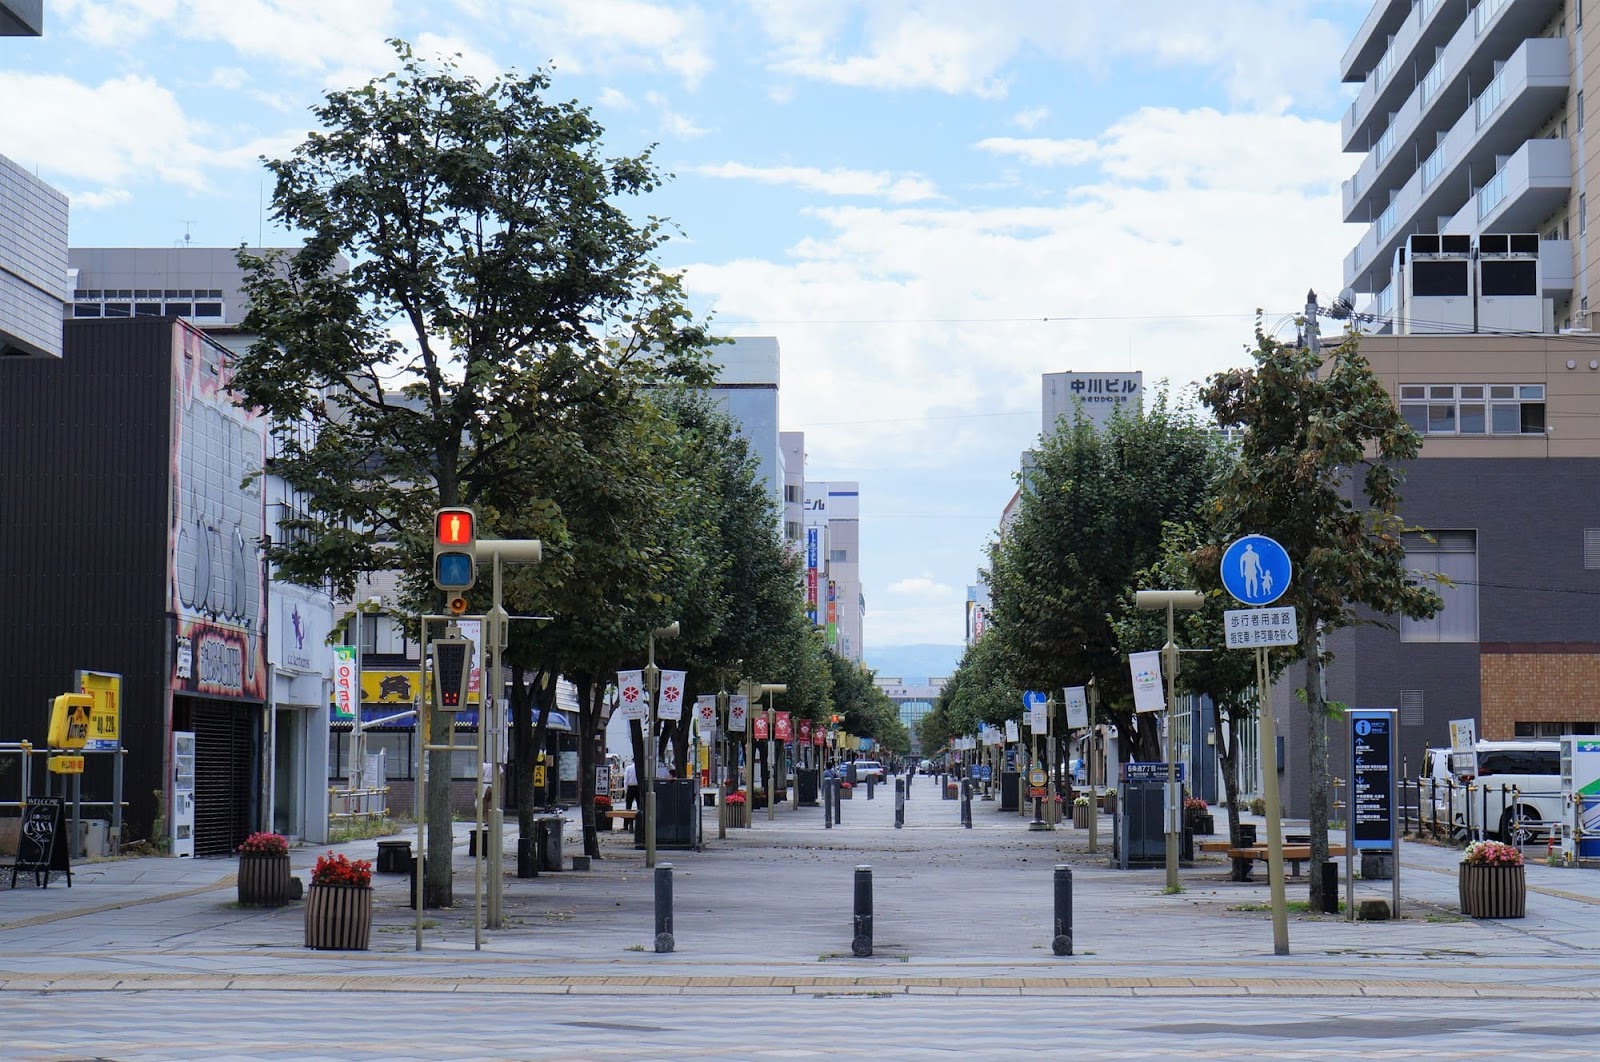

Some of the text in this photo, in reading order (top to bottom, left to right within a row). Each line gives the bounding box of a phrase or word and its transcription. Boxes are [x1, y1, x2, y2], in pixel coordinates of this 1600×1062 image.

[1071, 378, 1137, 394] 中川ビル
[1230, 612, 1290, 627] 歩行者用道路
[28, 798, 58, 806] WELCOME
[23, 820, 53, 836] CASA
